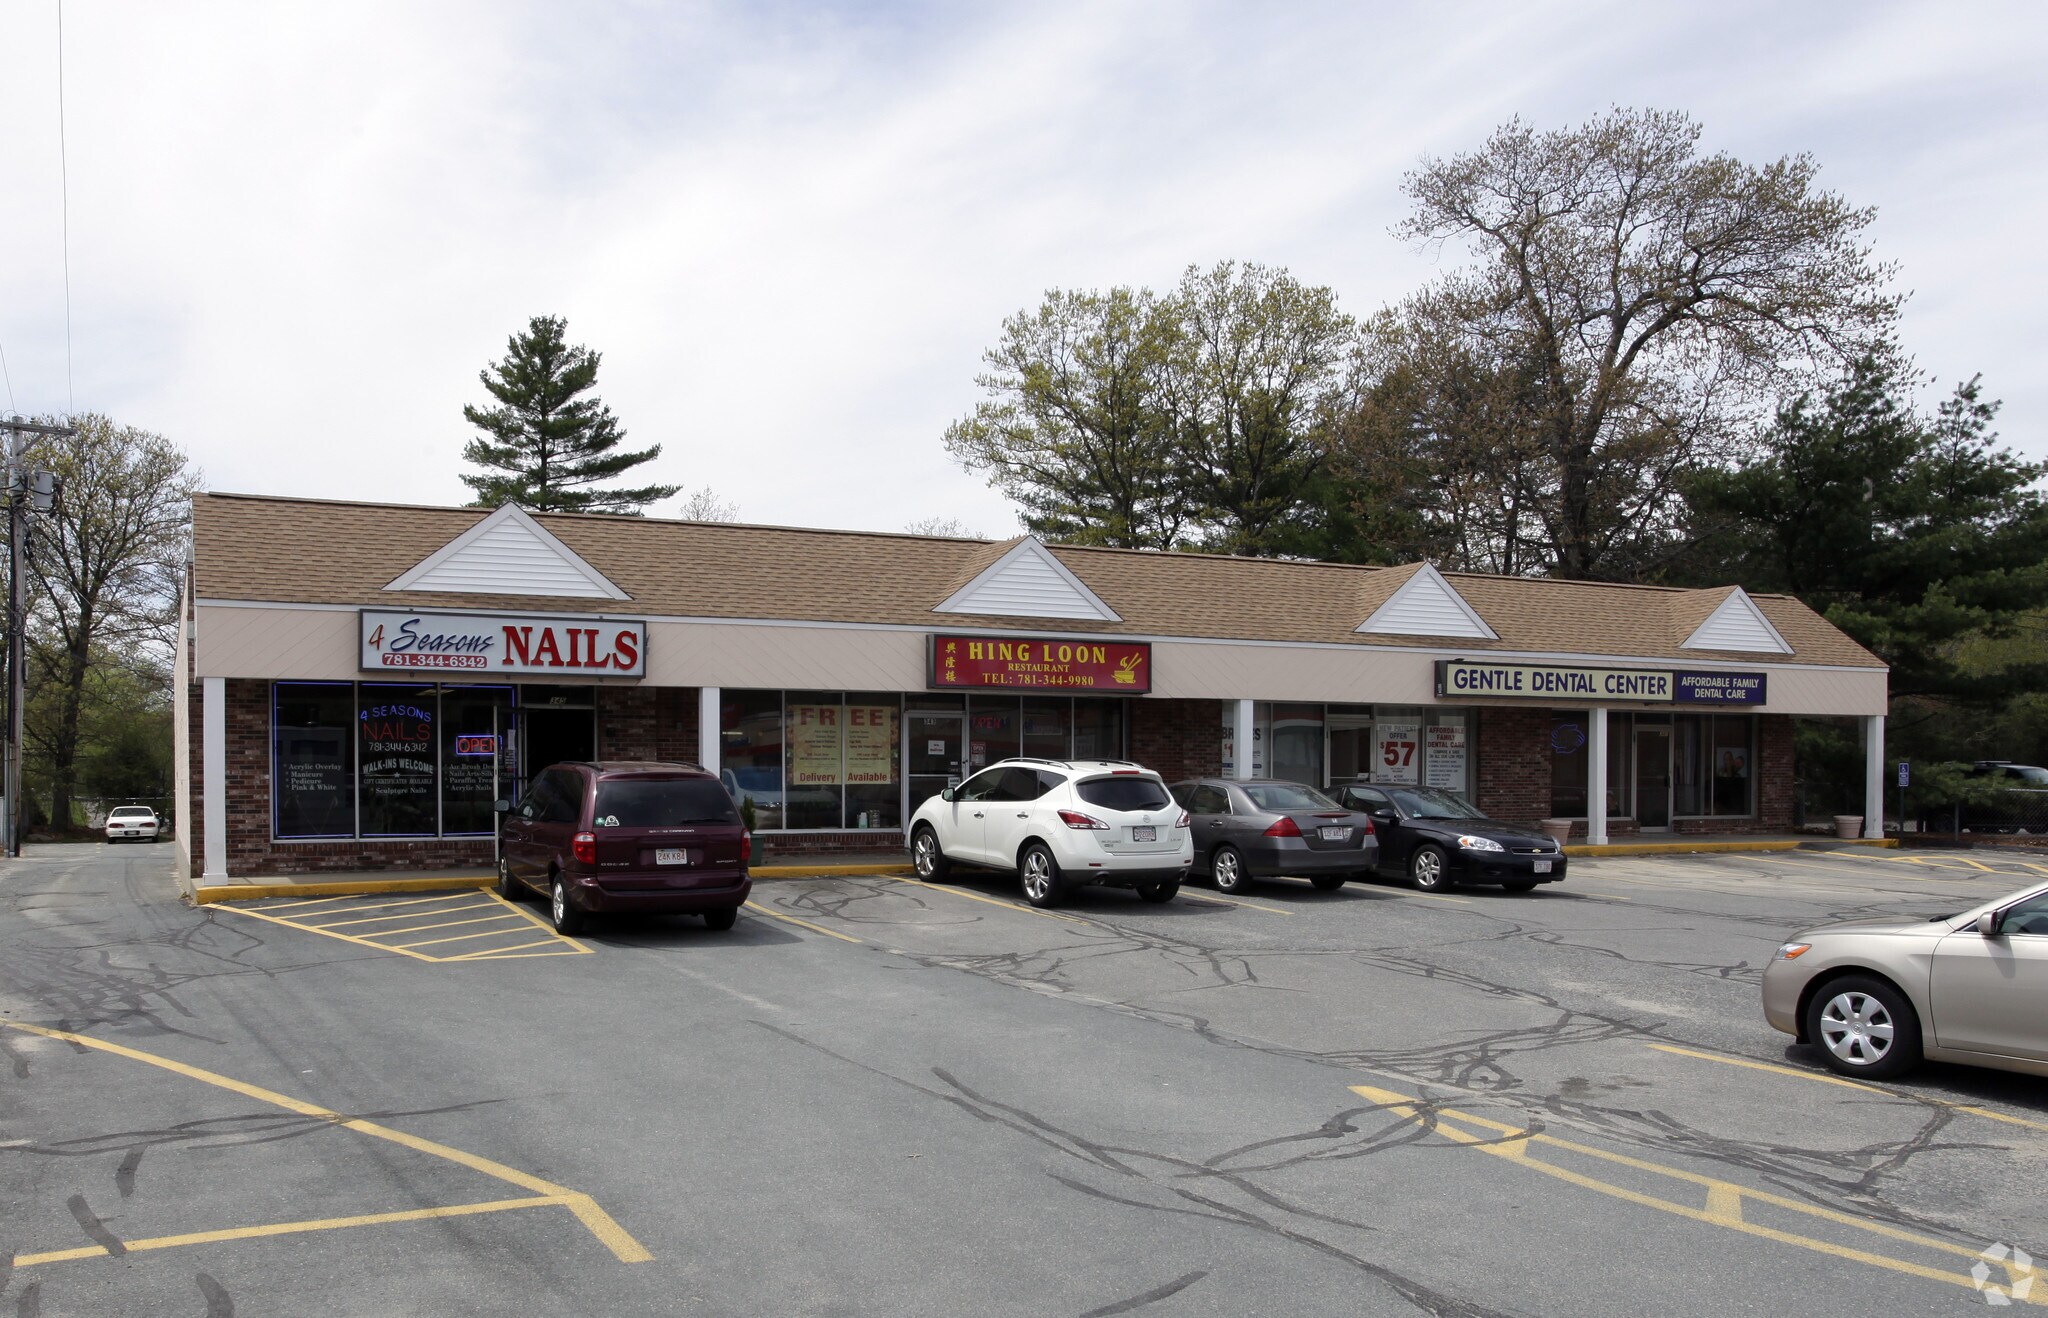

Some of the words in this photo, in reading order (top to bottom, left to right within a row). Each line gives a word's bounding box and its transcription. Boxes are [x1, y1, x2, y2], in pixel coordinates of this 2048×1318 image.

[369, 624, 384, 650] 4
[390, 618, 495, 653] Seasons
[502, 625, 639, 671] NAILS
[969, 642, 1030, 662] HING
[1043, 645, 1106, 664] LOON
[384, 654, 486, 669] 781-344-6342
[1007, 663, 1070, 673] RESTAURANT
[982, 673, 1013, 684] TEL:
[1018, 674, 1094, 686] 781-344-9980
[1454, 668, 1522, 691] GENTLE
[1532, 672, 1597, 693] DENTAL
[1604, 674, 1667, 695] CENTER
[1681, 676, 1730, 687] AFFORDABLE
[1733, 678, 1759, 688] FAMILY
[1694, 688, 1723, 698] DENTAL
[1726, 689, 1746, 699] CARE
[360, 710, 368, 720] 4
[372, 705, 432, 722] SEASONS
[363, 721, 431, 741] NAILS
[369, 742, 427, 752] 781-344-6342
[1380, 741, 1415, 767] $57
[289, 763, 313, 771] Acrylic
[315, 763, 342, 771] Overlay
[362, 758, 397, 775] WALK-INS
[399, 758, 434, 775] WELCOME
[800, 772, 836, 783] Delivery
[847, 772, 887, 781] Available
[657, 852, 671, 861] 24K
[672, 852, 686, 861] K84
